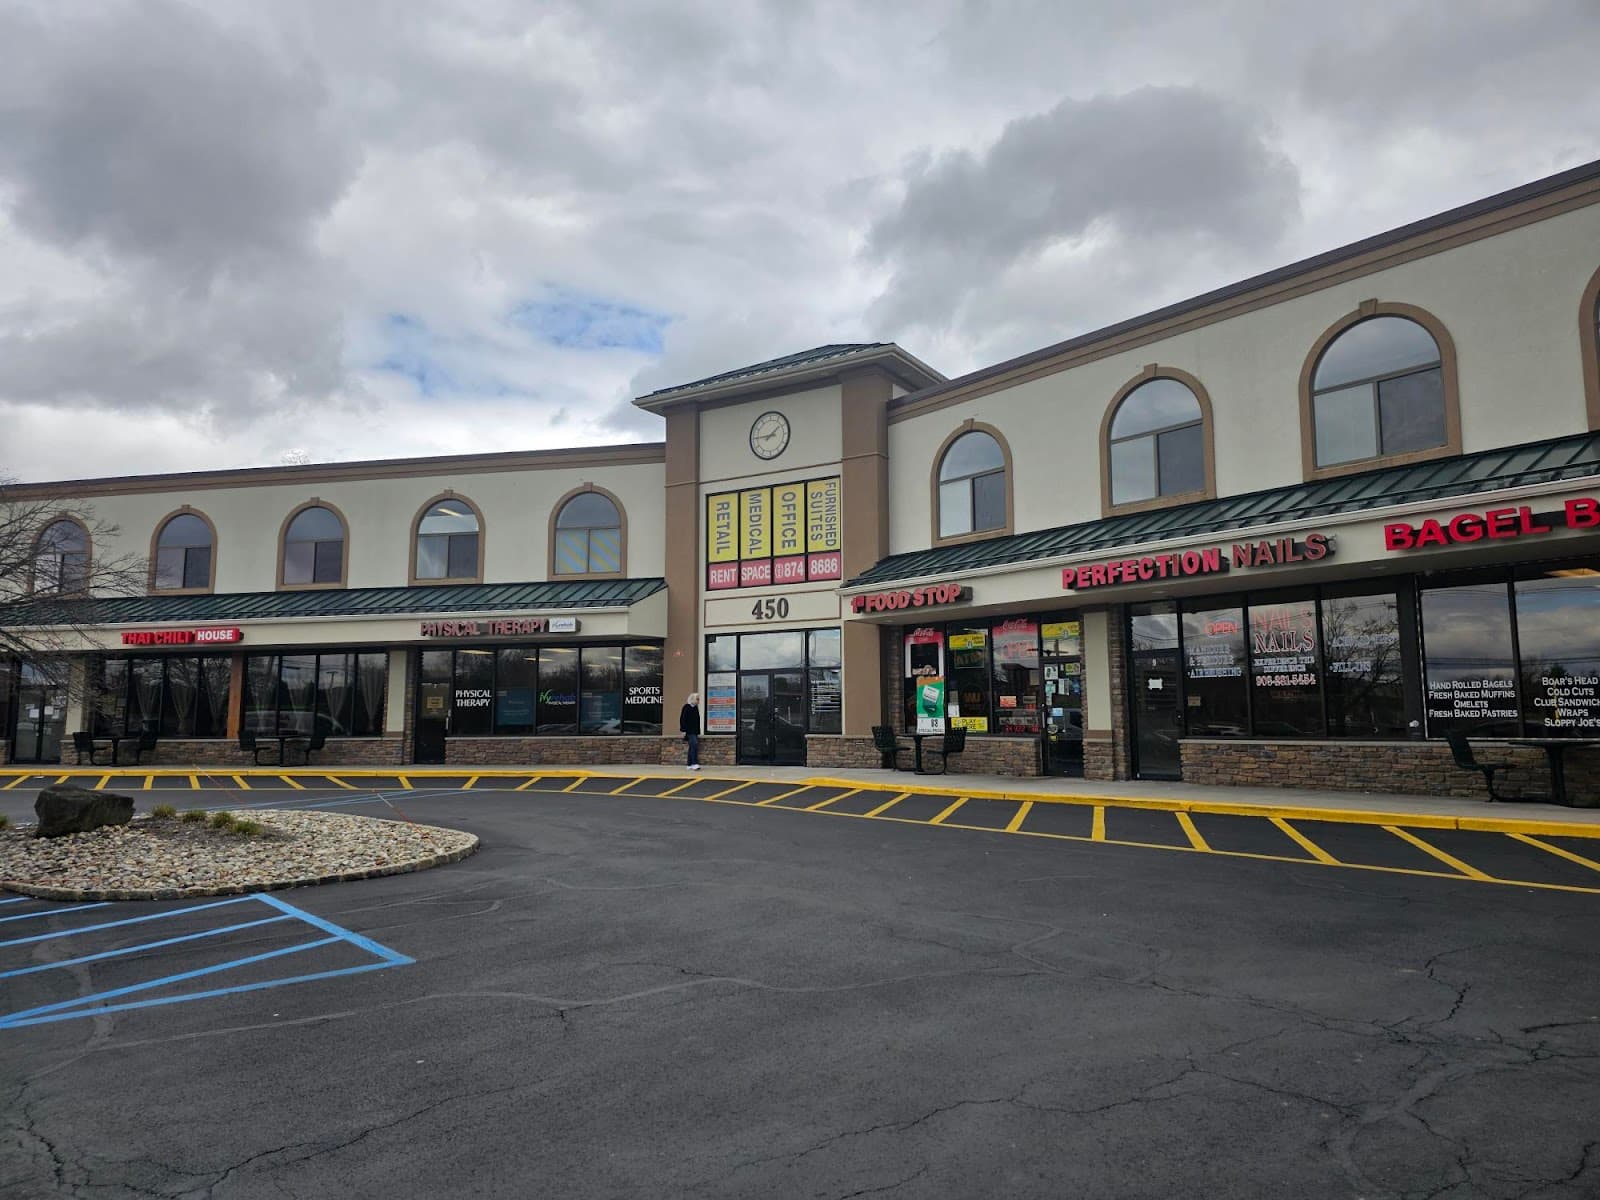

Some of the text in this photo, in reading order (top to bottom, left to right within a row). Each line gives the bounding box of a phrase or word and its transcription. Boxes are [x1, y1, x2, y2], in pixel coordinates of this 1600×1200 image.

[781, 491, 797, 549] OFFICE
[810, 491, 823, 542] SUITES
[824, 481, 837, 547] FURNISHED
[716, 501, 731, 555] RETAIL
[748, 493, 763, 555] MEDICAL
[1384, 505, 1550, 551] BAGEL
[1062, 533, 1326, 589] PERFECTION NAILS
[711, 568, 737, 584] RENT
[741, 564, 771, 581] SPACE
[810, 557, 838, 575] 8686
[865, 590, 911, 612] FOOD
[913, 583, 961, 607] STOP
[751, 597, 790, 620] 450
[420, 617, 548, 637] PHYSICAL THERAPY
[1205, 621, 1238, 635] OPEN
[121, 629, 234, 645] THAI CHILI HOUSE
[1254, 629, 1316, 654] NAILS
[1429, 680, 1514, 690] HAND ROLLED BAGELS
[1542, 676, 1599, 686] BOAR'S HEAD
[455, 689, 492, 698] PHYSICAL
[629, 686, 660, 695] SPORTS
[1428, 689, 1516, 700] FRESH BAKED MUFFINS
[1547, 686, 1595, 696] COLD CUTS
[455, 698, 491, 707] THERAPY
[624, 695, 664, 705] MEDICINE
[1453, 699, 1489, 709] OMELETS
[1534, 697, 1557, 707] CLUB
[1428, 709, 1518, 718] FRESH BAKED PASTRIES
[1557, 708, 1589, 717] WRAPS
[1544, 717, 1577, 727] SLOPPY
